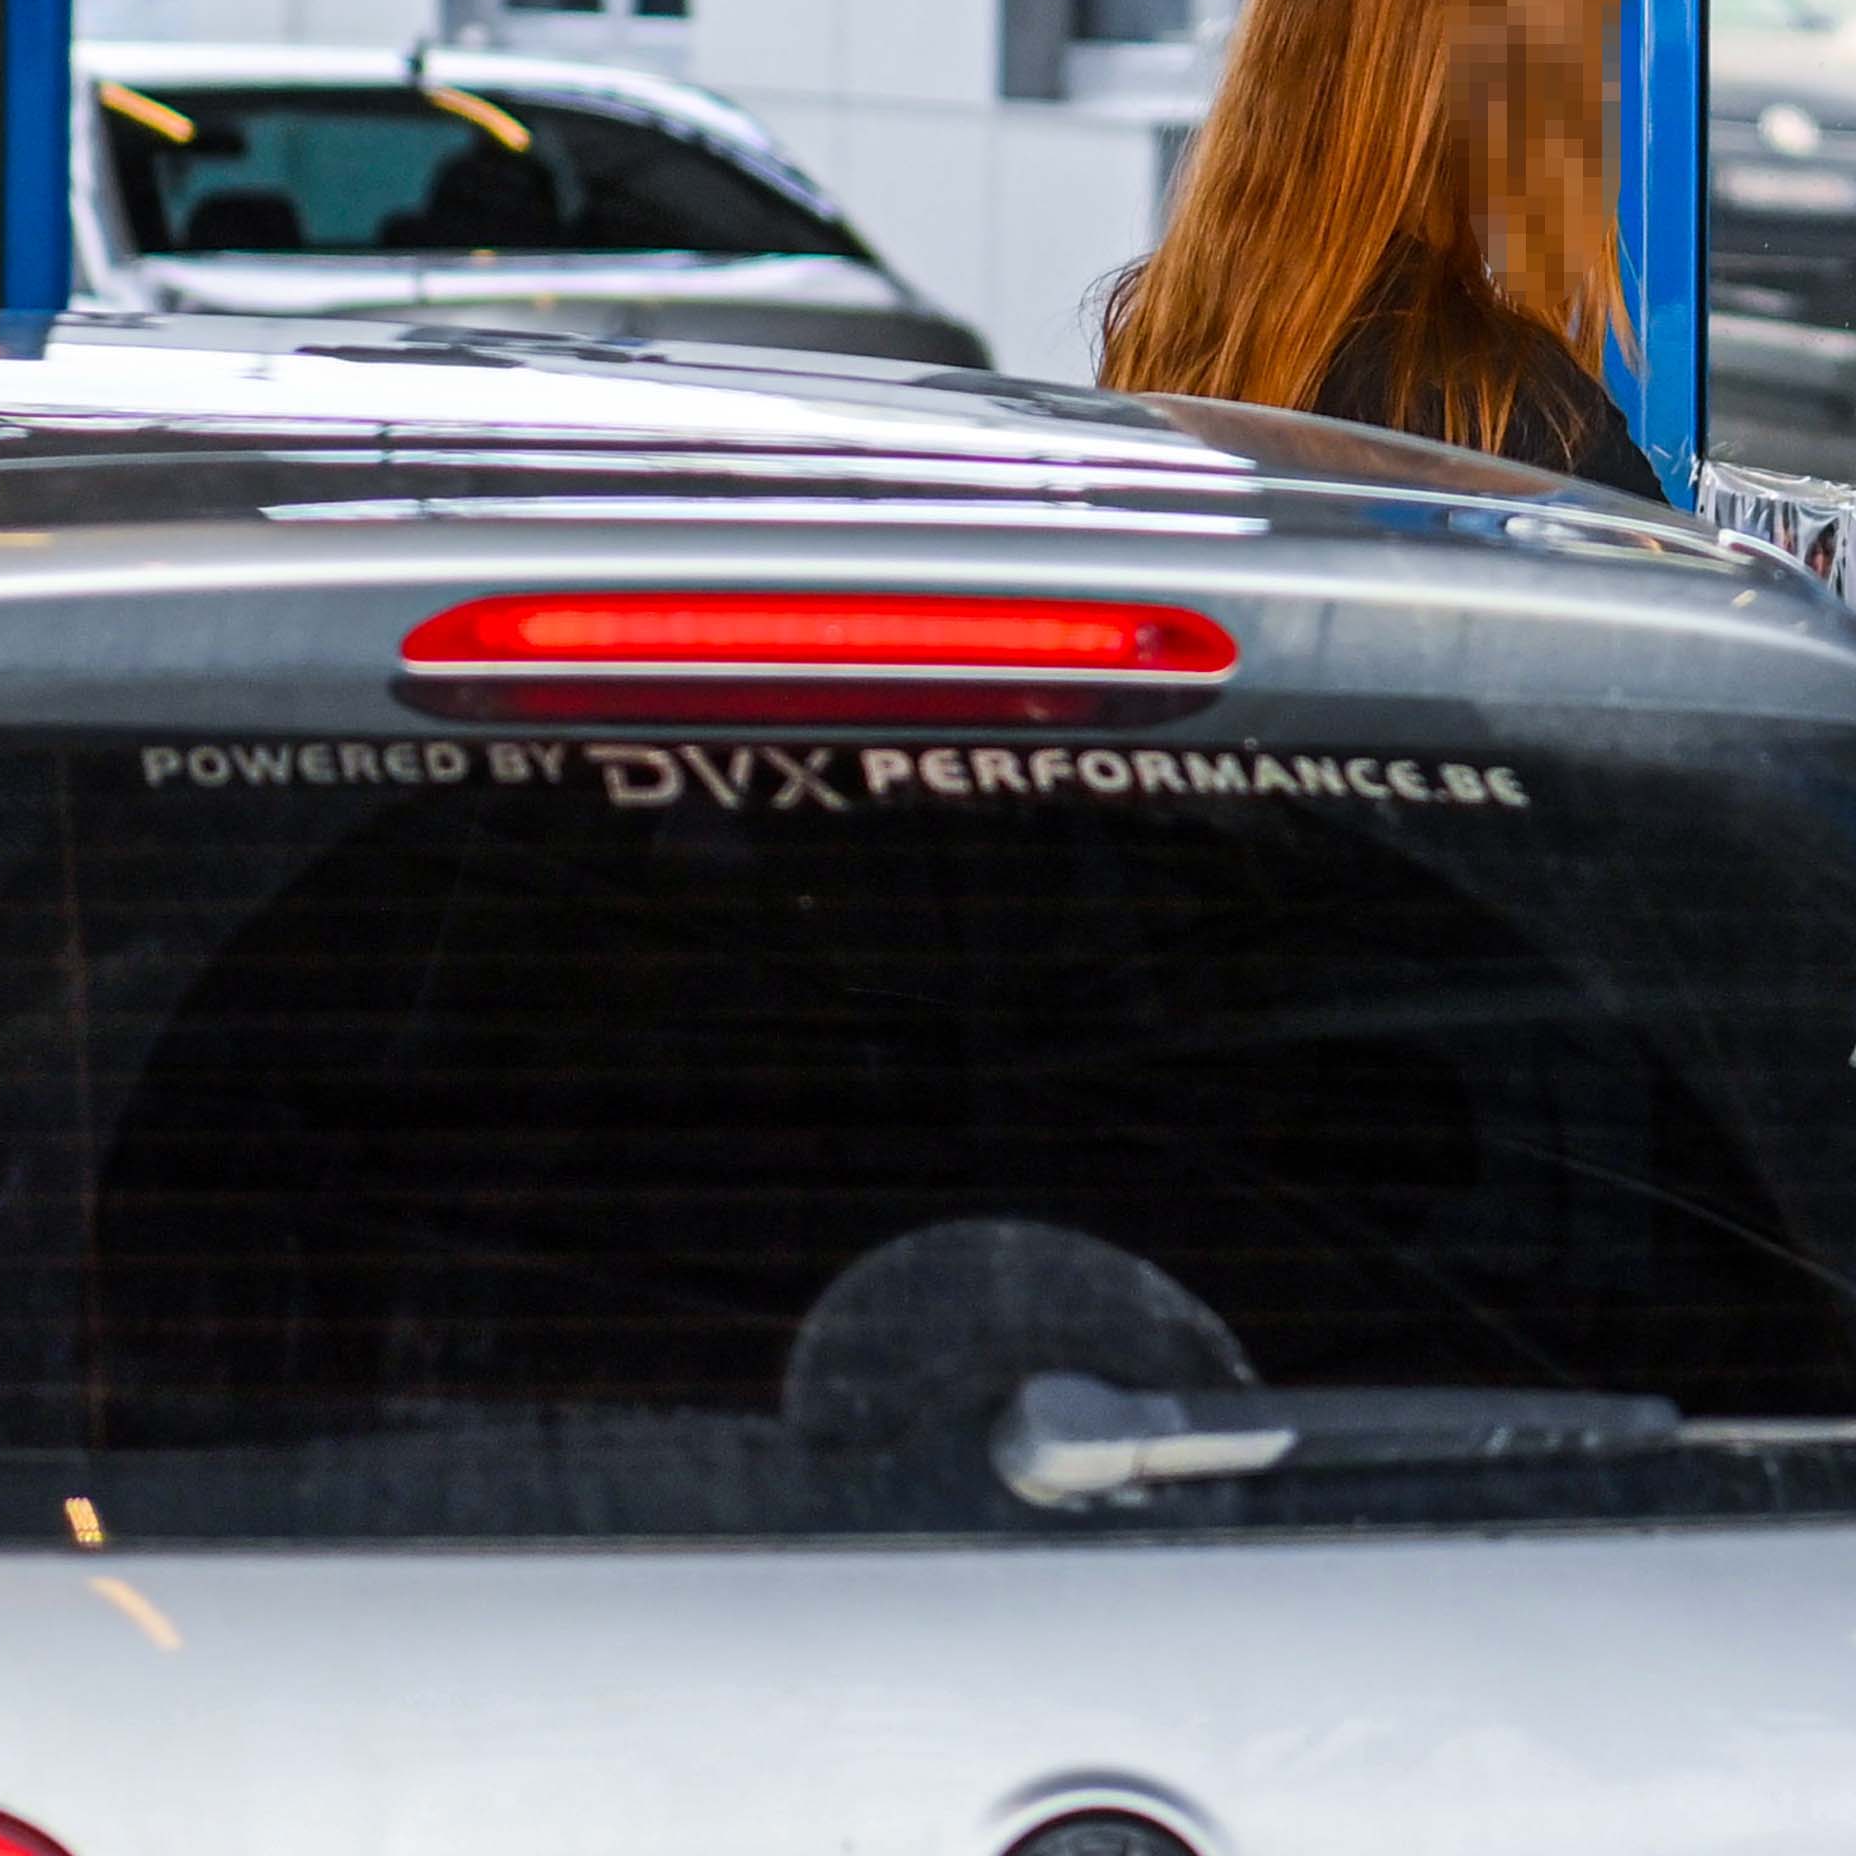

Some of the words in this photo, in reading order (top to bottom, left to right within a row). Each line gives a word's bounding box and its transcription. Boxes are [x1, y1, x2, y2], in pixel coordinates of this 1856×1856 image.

[143, 744, 470, 787] POWERED
[485, 744, 564, 785] BY
[584, 744, 849, 811] DVX
[860, 747, 1531, 808] PERFORMANCE.BE
